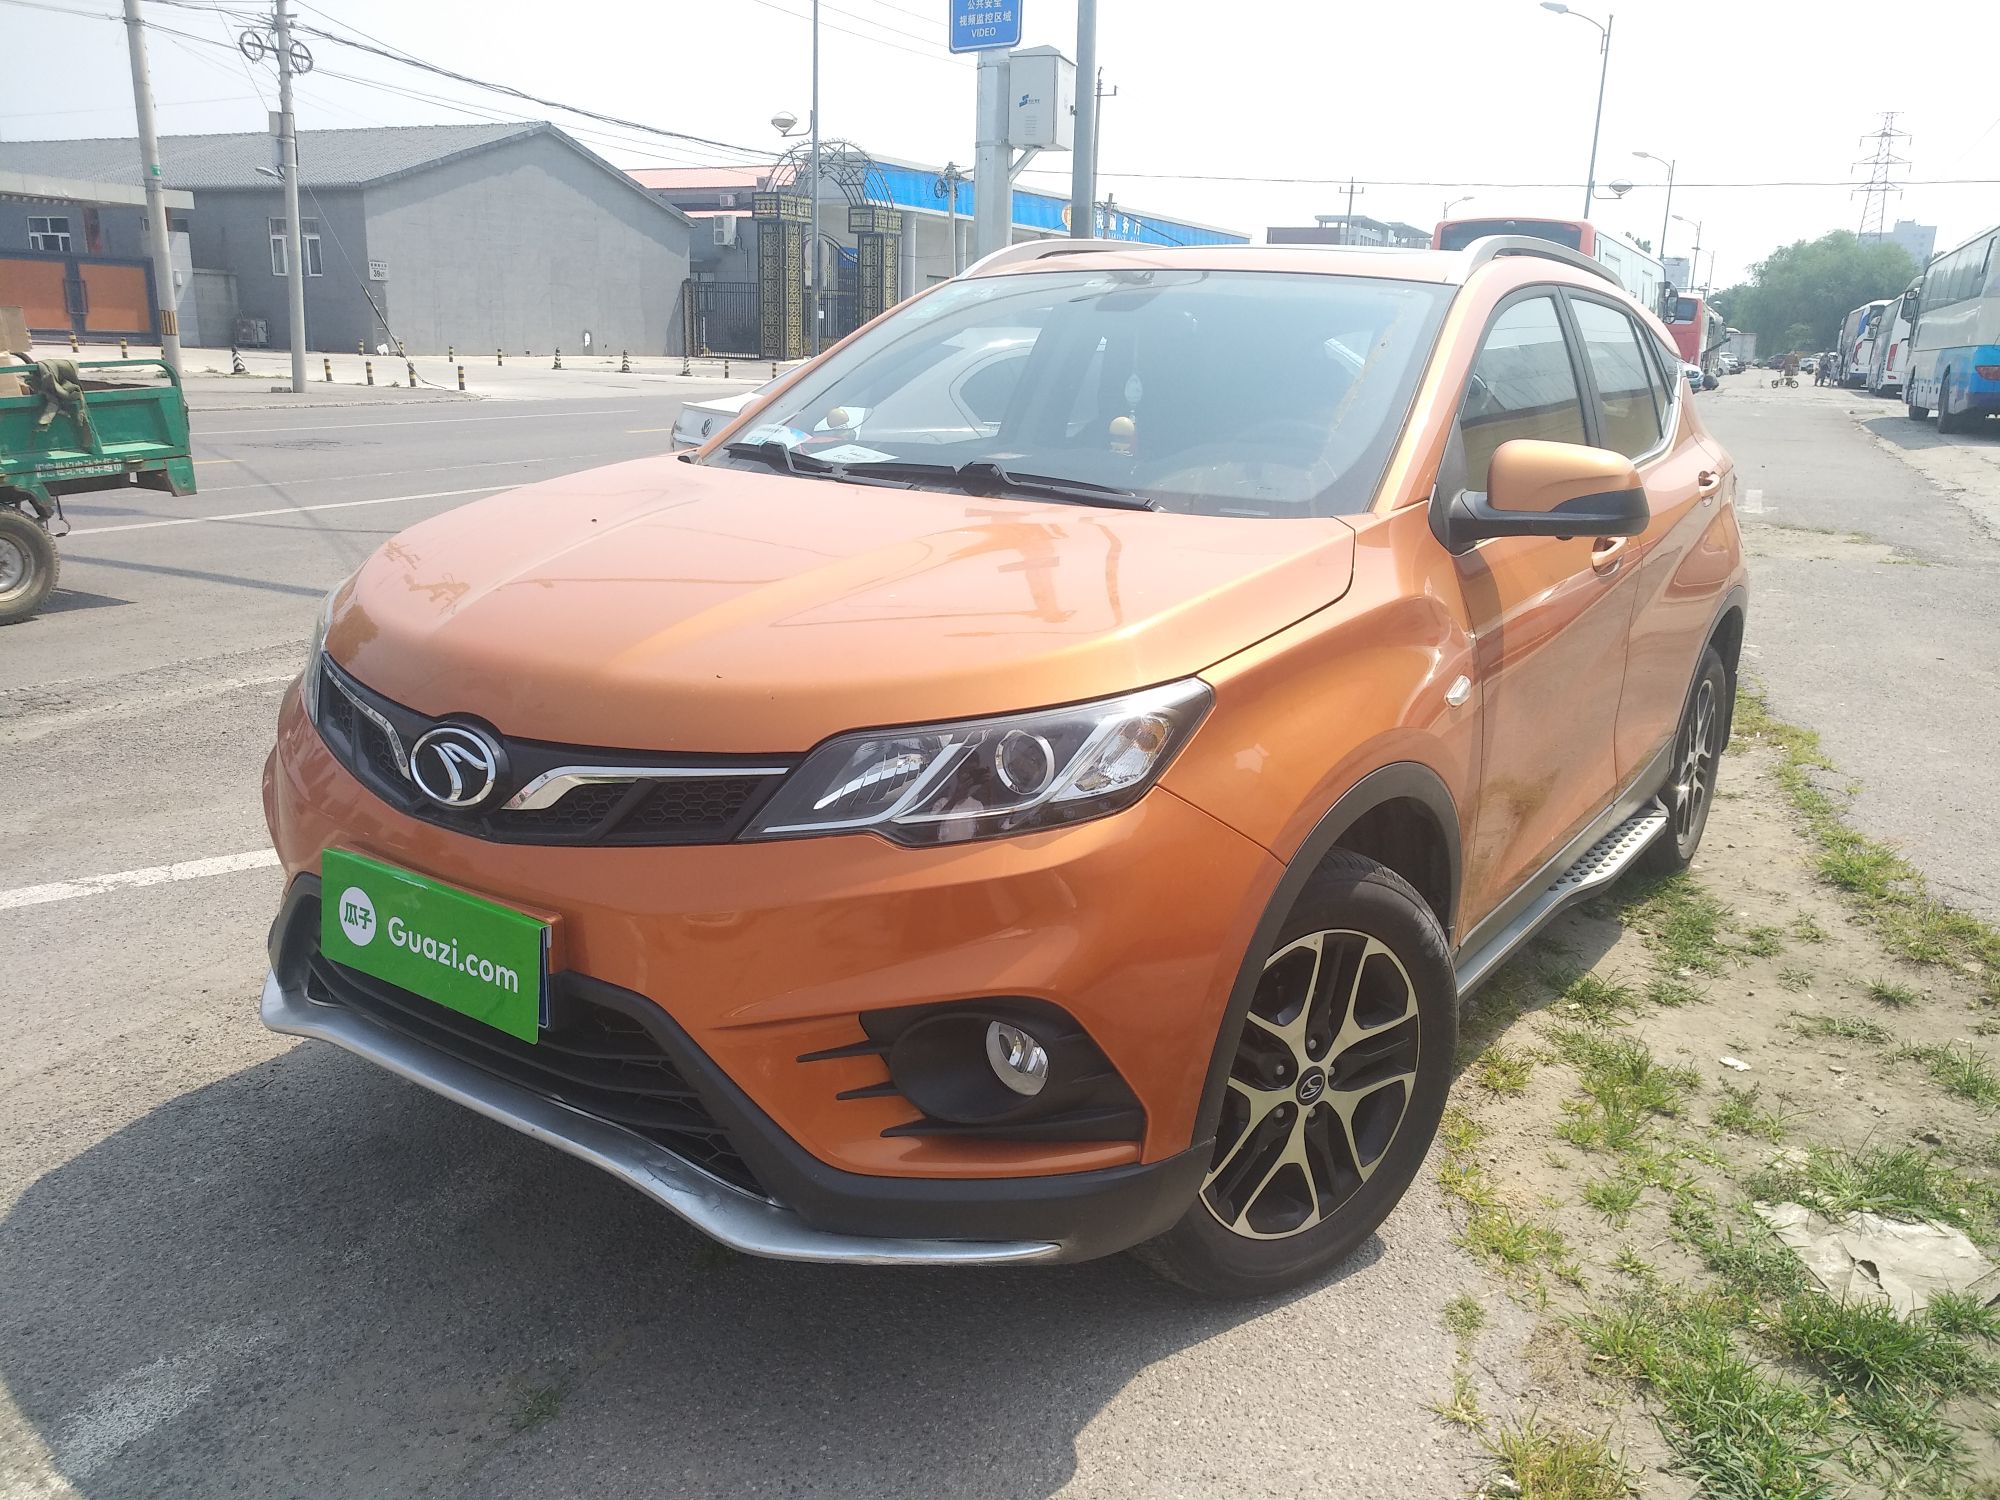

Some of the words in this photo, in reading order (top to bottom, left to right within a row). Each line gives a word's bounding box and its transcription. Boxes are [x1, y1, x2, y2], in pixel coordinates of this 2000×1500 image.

[967, 0, 1002, 10] 公共安全
[959, 10, 1012, 27] 视频监控区域
[971, 27, 996, 38] VIDEO
[344, 902, 372, 930] 瓜子
[387, 916, 519, 994] Guazi.com
